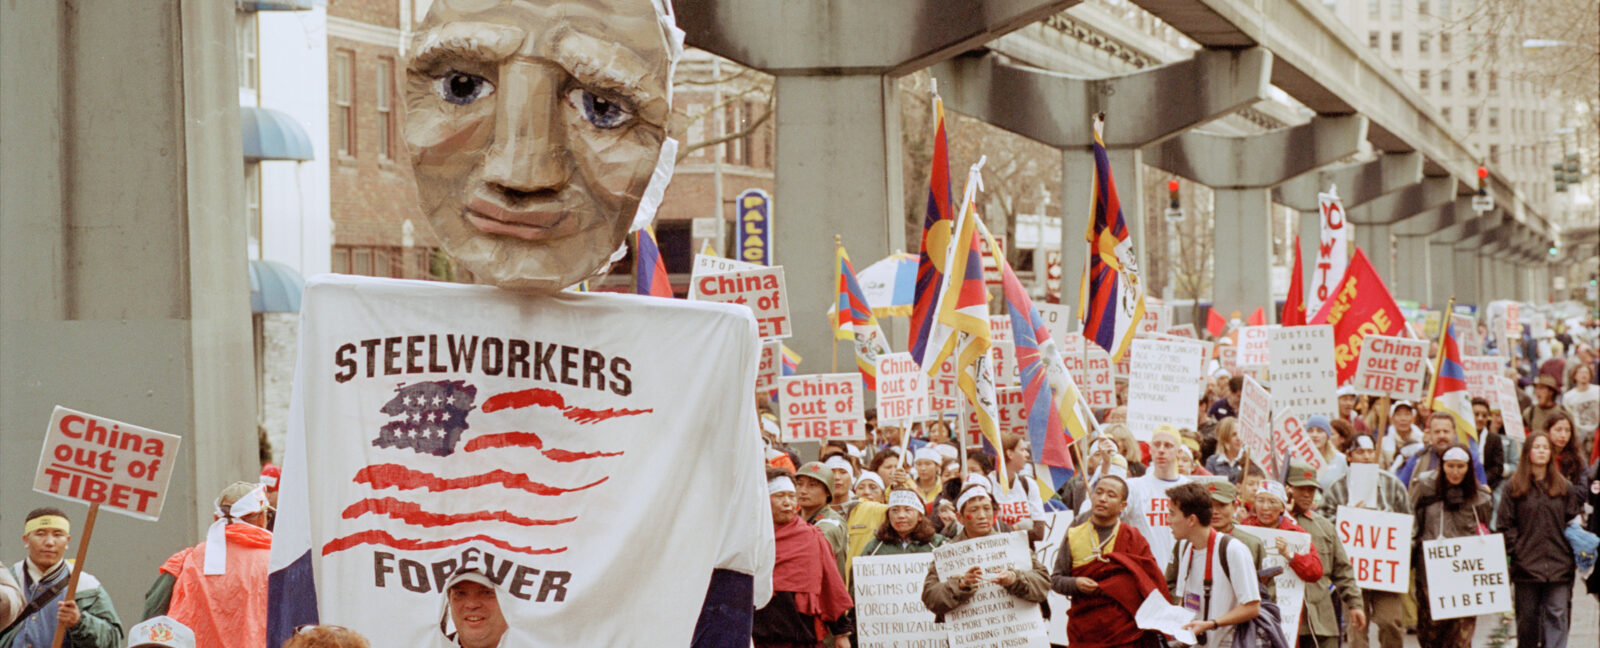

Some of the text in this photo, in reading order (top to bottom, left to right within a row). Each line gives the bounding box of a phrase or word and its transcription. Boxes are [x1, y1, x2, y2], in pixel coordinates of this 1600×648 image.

[701, 258, 735, 271] STOP
[1317, 238, 1336, 301] WTO
[699, 273, 779, 296] China
[757, 291, 779, 310] of
[1273, 329, 1325, 340] JUSTICE
[1336, 308, 1392, 369] RADE
[1370, 338, 1422, 358] China
[334, 333, 632, 397] STEELWORKERS
[759, 357, 773, 370] of
[880, 357, 920, 375] China
[1064, 356, 1109, 370] Chna
[1367, 356, 1420, 374] out of
[1096, 370, 1110, 384] of
[1272, 370, 1334, 380] RIGHTS TO
[1363, 374, 1419, 393] TIBET
[786, 378, 854, 397] China
[881, 377, 905, 393] out
[1293, 385, 1313, 393] ALL
[788, 395, 854, 415] out of
[60, 414, 164, 458] China
[787, 418, 858, 438] TIBET
[54, 444, 161, 482] out of
[45, 468, 158, 512] TIBET
[1340, 521, 1397, 550] SAVE
[1428, 545, 1461, 559] HELP
[856, 561, 929, 577] TIBETAN WOM
[1452, 559, 1485, 572] SAVE
[1473, 573, 1504, 586] FREE
[857, 581, 921, 597] VICTIMS OF
[1438, 592, 1496, 608] TIBET
[857, 601, 927, 617] FORCED ABOR
[859, 622, 869, 637] &
